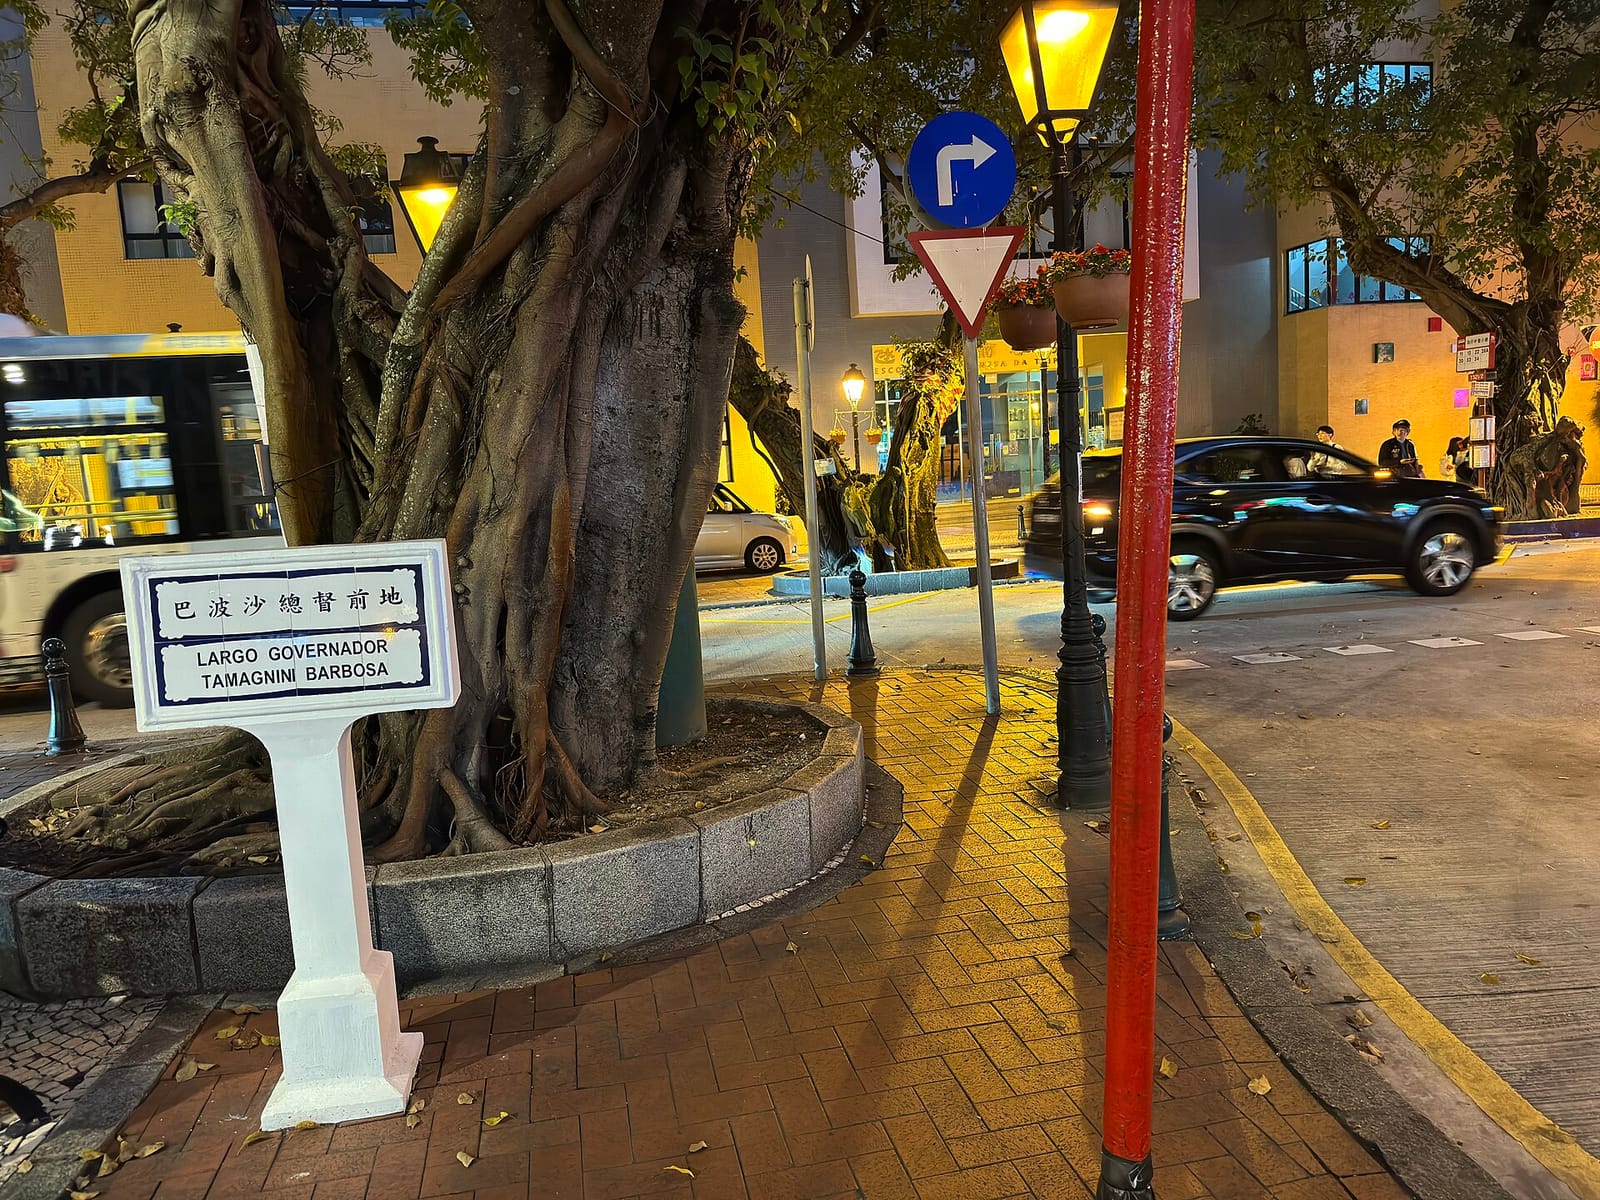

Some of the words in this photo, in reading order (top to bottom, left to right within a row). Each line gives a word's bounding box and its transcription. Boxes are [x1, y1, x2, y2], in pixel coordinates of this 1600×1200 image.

[874, 366, 902, 375] ESCO
[174, 586, 403, 620] 巴波沙總督前地
[197, 647, 258, 667] LARGO
[268, 638, 388, 662] GOVERNADOR
[201, 668, 296, 689] TAMAGNINI
[306, 662, 389, 682] BARBOSA
